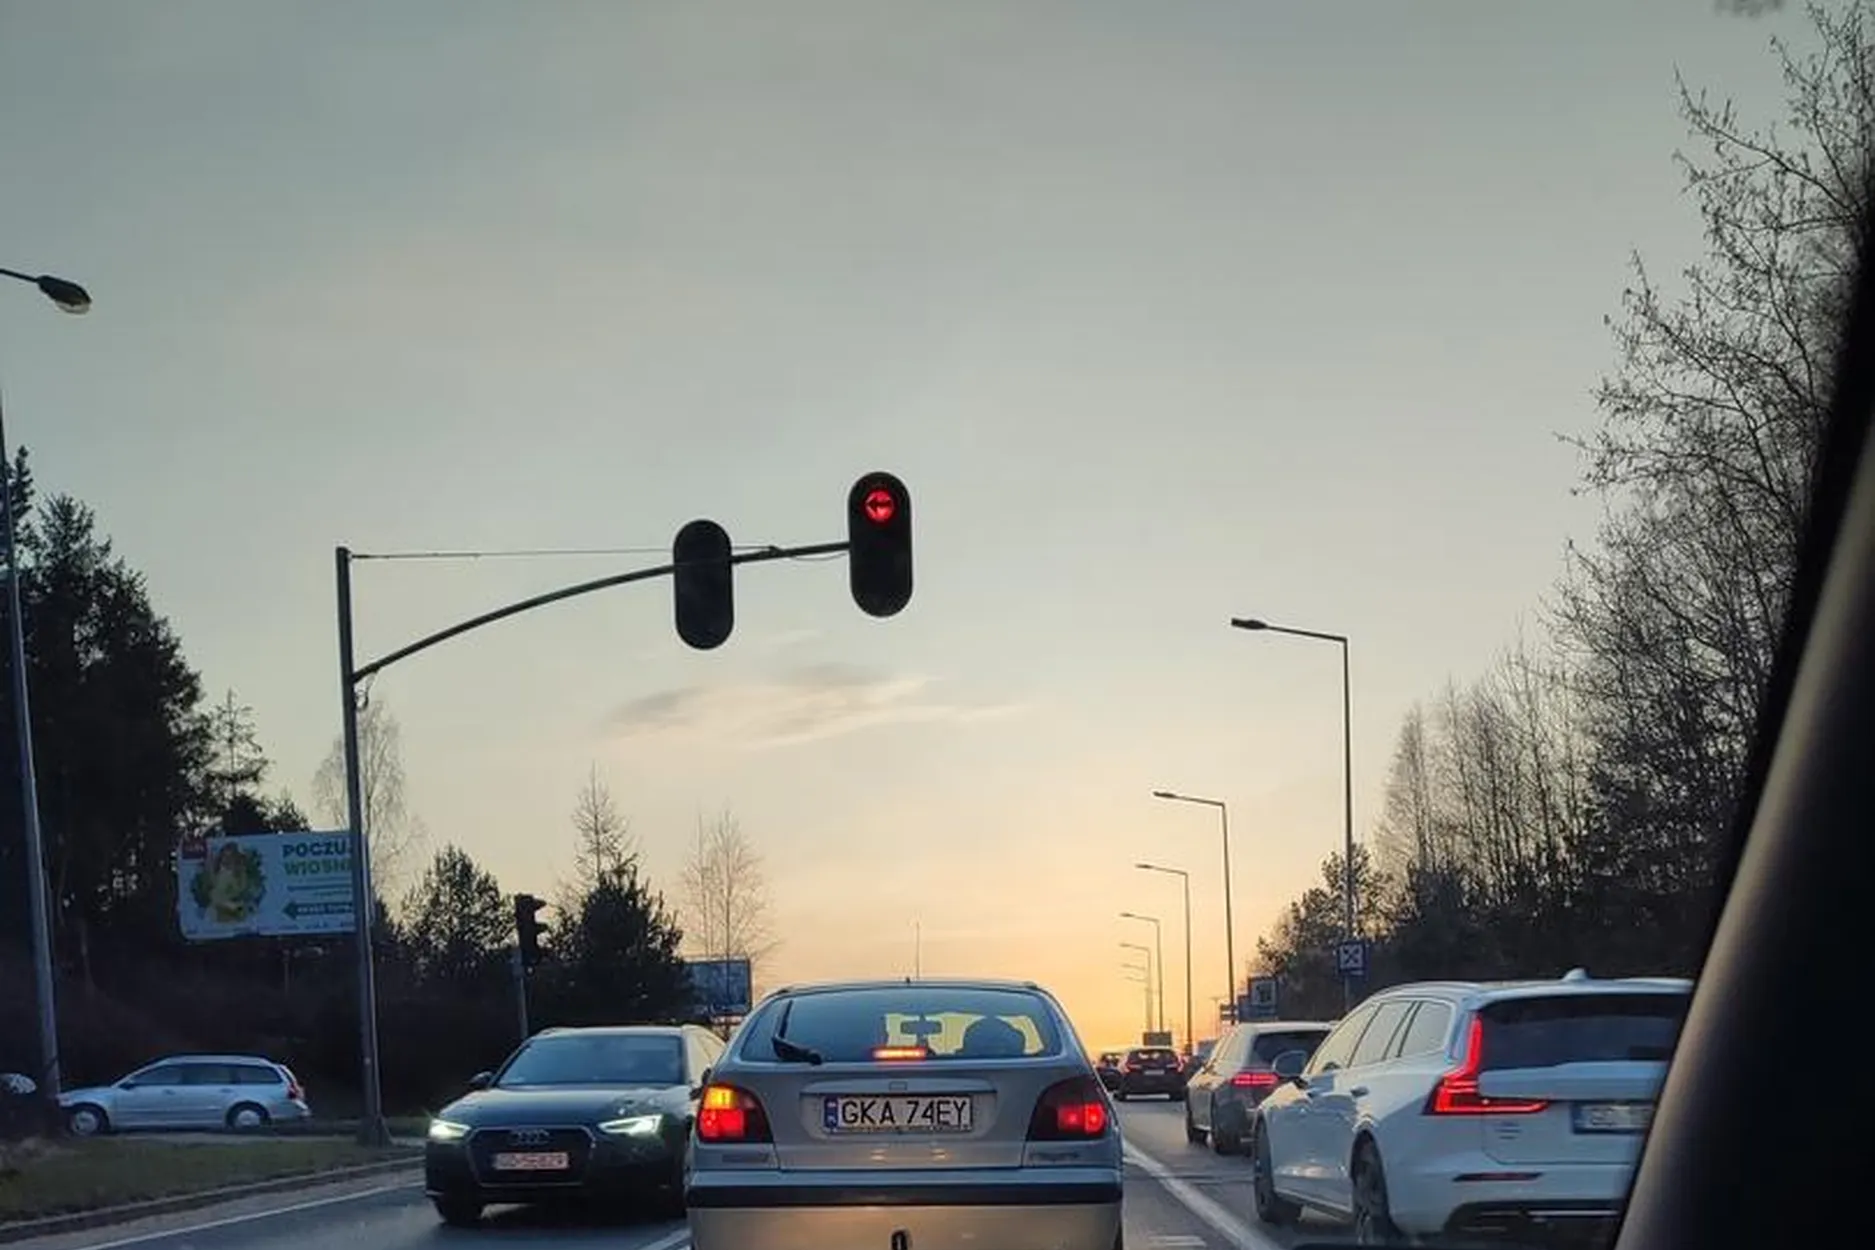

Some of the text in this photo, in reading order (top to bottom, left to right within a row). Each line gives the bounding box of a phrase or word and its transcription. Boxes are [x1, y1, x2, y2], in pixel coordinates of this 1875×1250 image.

[282, 841, 353, 858] POCZU
[842, 1100, 895, 1124] GKA
[906, 1100, 967, 1126] 74EY
